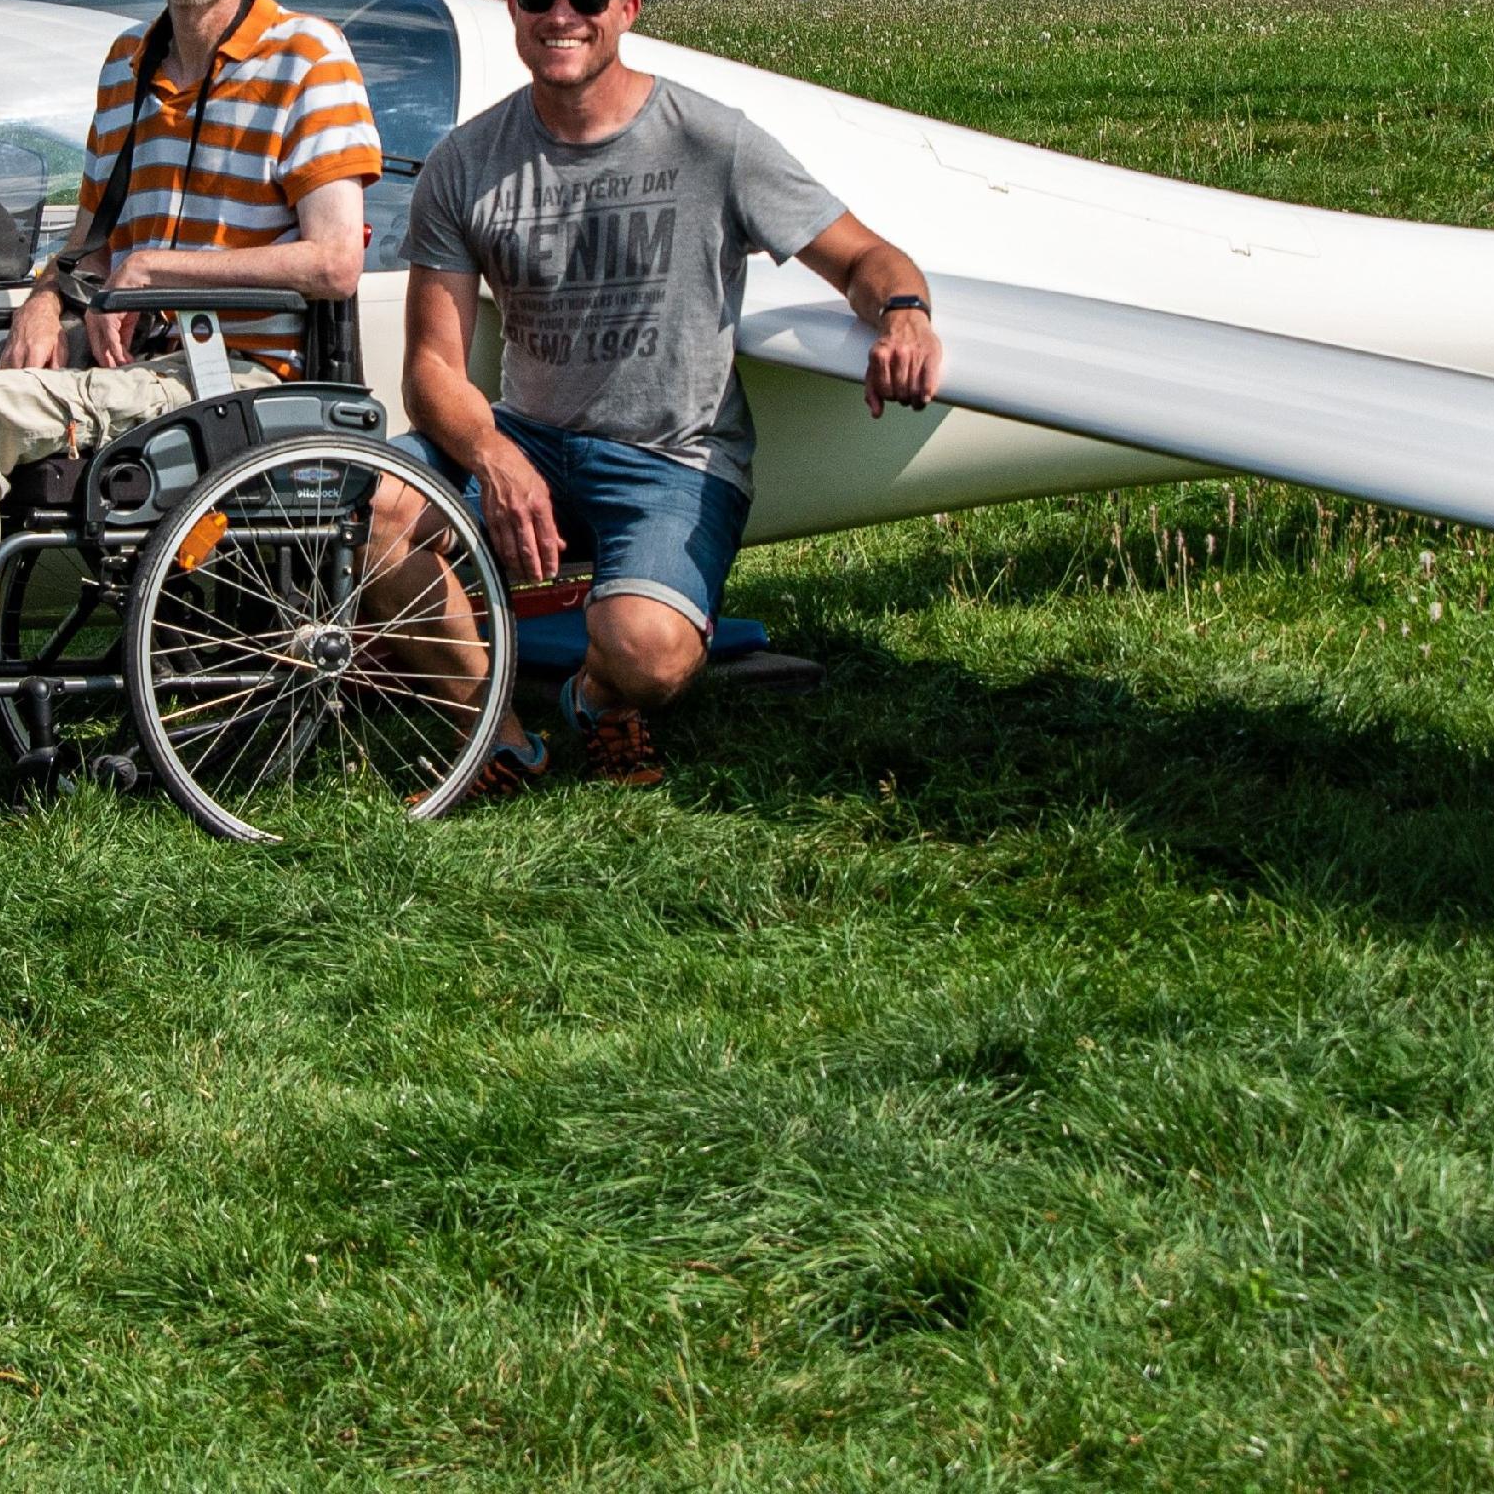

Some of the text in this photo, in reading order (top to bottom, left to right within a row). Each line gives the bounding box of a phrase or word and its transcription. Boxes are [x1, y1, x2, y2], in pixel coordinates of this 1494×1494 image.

[572, 175, 634, 203] EVERY
[642, 167, 679, 195] DAY
[491, 207, 677, 289] DENIM
[505, 325, 659, 365] BLEND 1993
